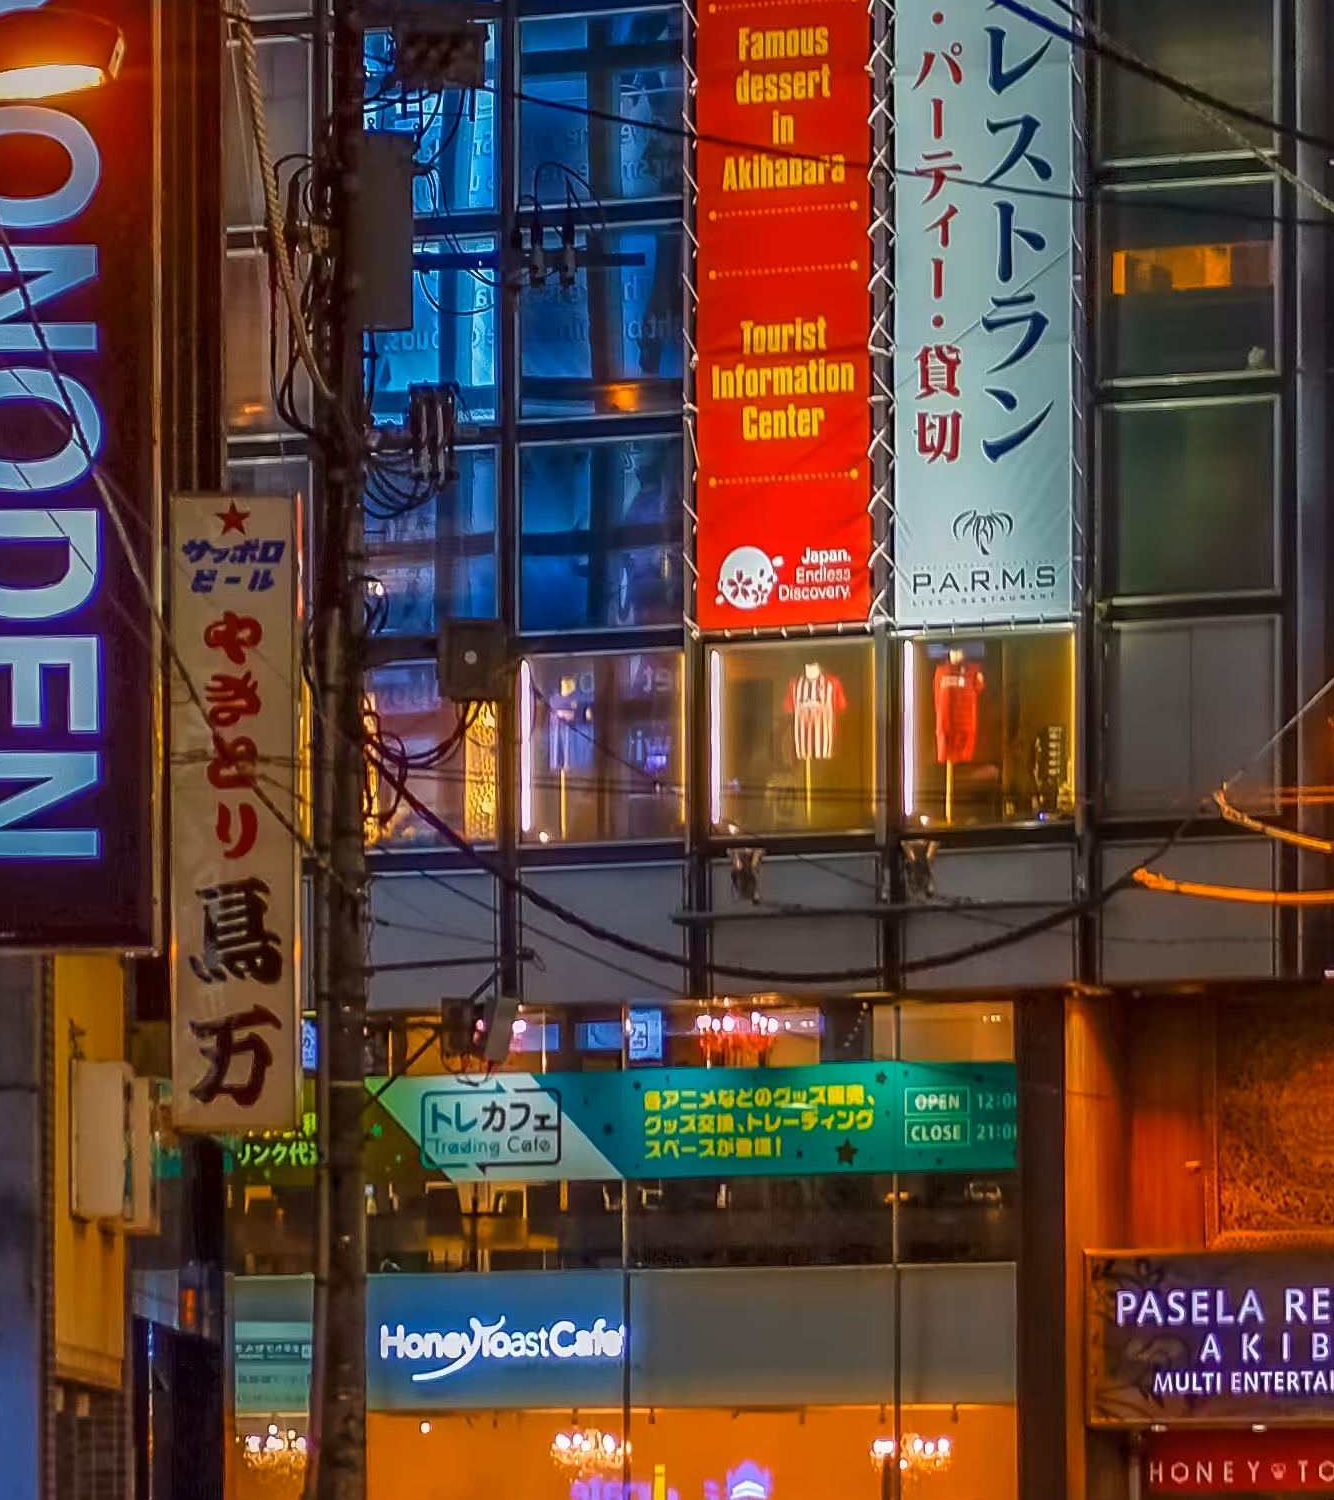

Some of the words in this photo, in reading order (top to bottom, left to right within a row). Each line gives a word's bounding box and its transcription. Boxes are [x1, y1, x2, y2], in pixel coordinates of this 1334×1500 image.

[738, 25, 829, 61] Famous
[735, 64, 830, 104] dessert
[772, 110, 796, 145] in
[722, 152, 846, 193] Akihabara
[740, 315, 828, 355] Tourist
[711, 358, 856, 401] Information
[742, 402, 826, 442] Center
[182, 537, 287, 566] サッポロ
[801, 546, 852, 567] Japan.
[190, 567, 275, 595] ビール
[795, 566, 852, 585] Endless
[203, 610, 263, 860] やきとり
[430, 1101, 559, 1133] トレカフェ
[914, 1093, 960, 1111] OPEN
[427, 1136, 501, 1158] Trading
[911, 1123, 961, 1142] CLOSE
[1116, 1288, 1265, 1327] PASELA
[1153, 1371, 1222, 1395] MULTI
[1149, 1460, 1261, 1485] HONEY
